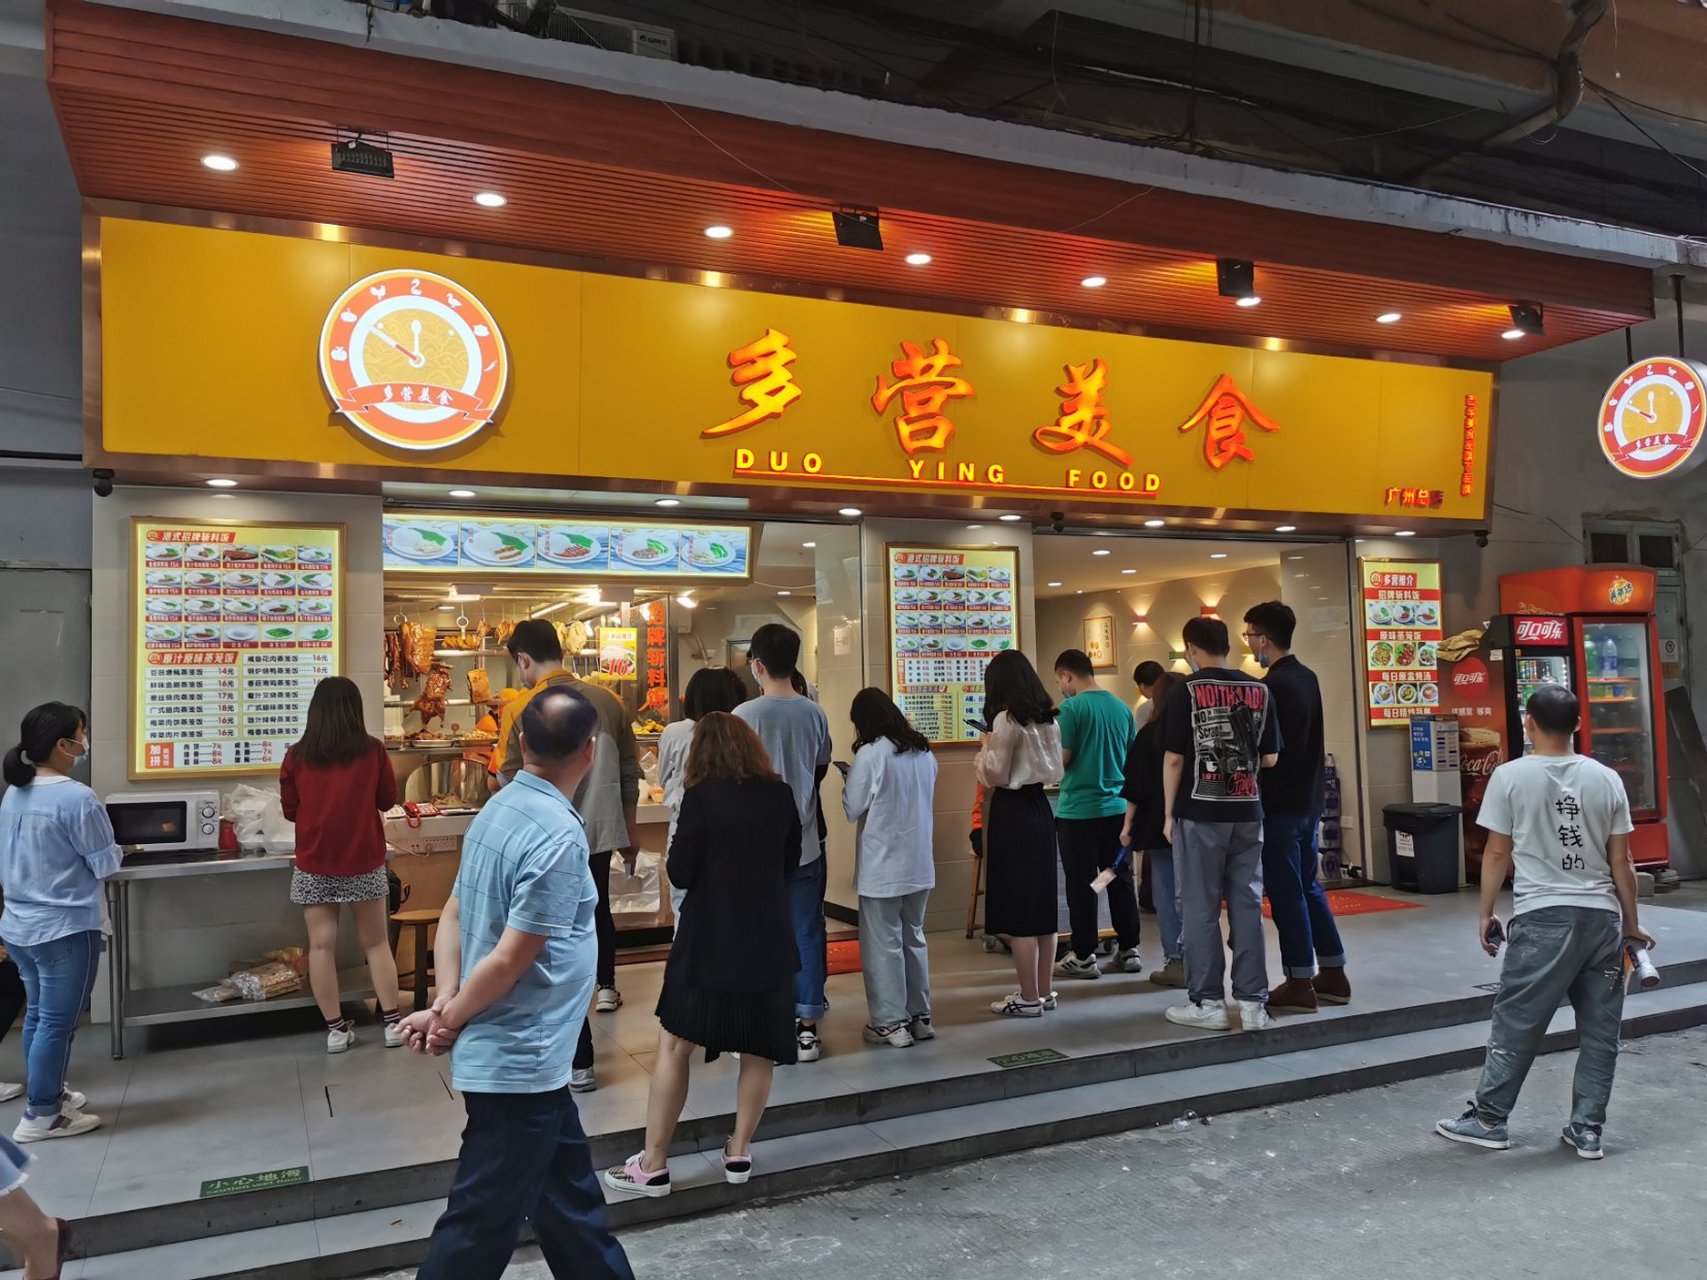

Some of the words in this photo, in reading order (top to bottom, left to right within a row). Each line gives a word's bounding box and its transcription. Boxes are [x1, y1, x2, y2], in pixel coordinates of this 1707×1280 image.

[383, 384, 454, 406] 多营美食
[701, 328, 1280, 470] 多营美食
[1635, 433, 1672, 449] 多营美食
[735, 447, 823, 474] DUO
[908, 458, 1006, 485] YING
[1067, 468, 1162, 493] FOOD
[1383, 574, 1414, 587] 多营推介
[1517, 619, 1566, 641] 可口可乐
[609, 658, 628, 676] 16
[1454, 671, 1485, 685] 可口可乐
[1555, 794, 1586, 871] 挣钱的
[208, 1168, 303, 1190] 小心地滑
